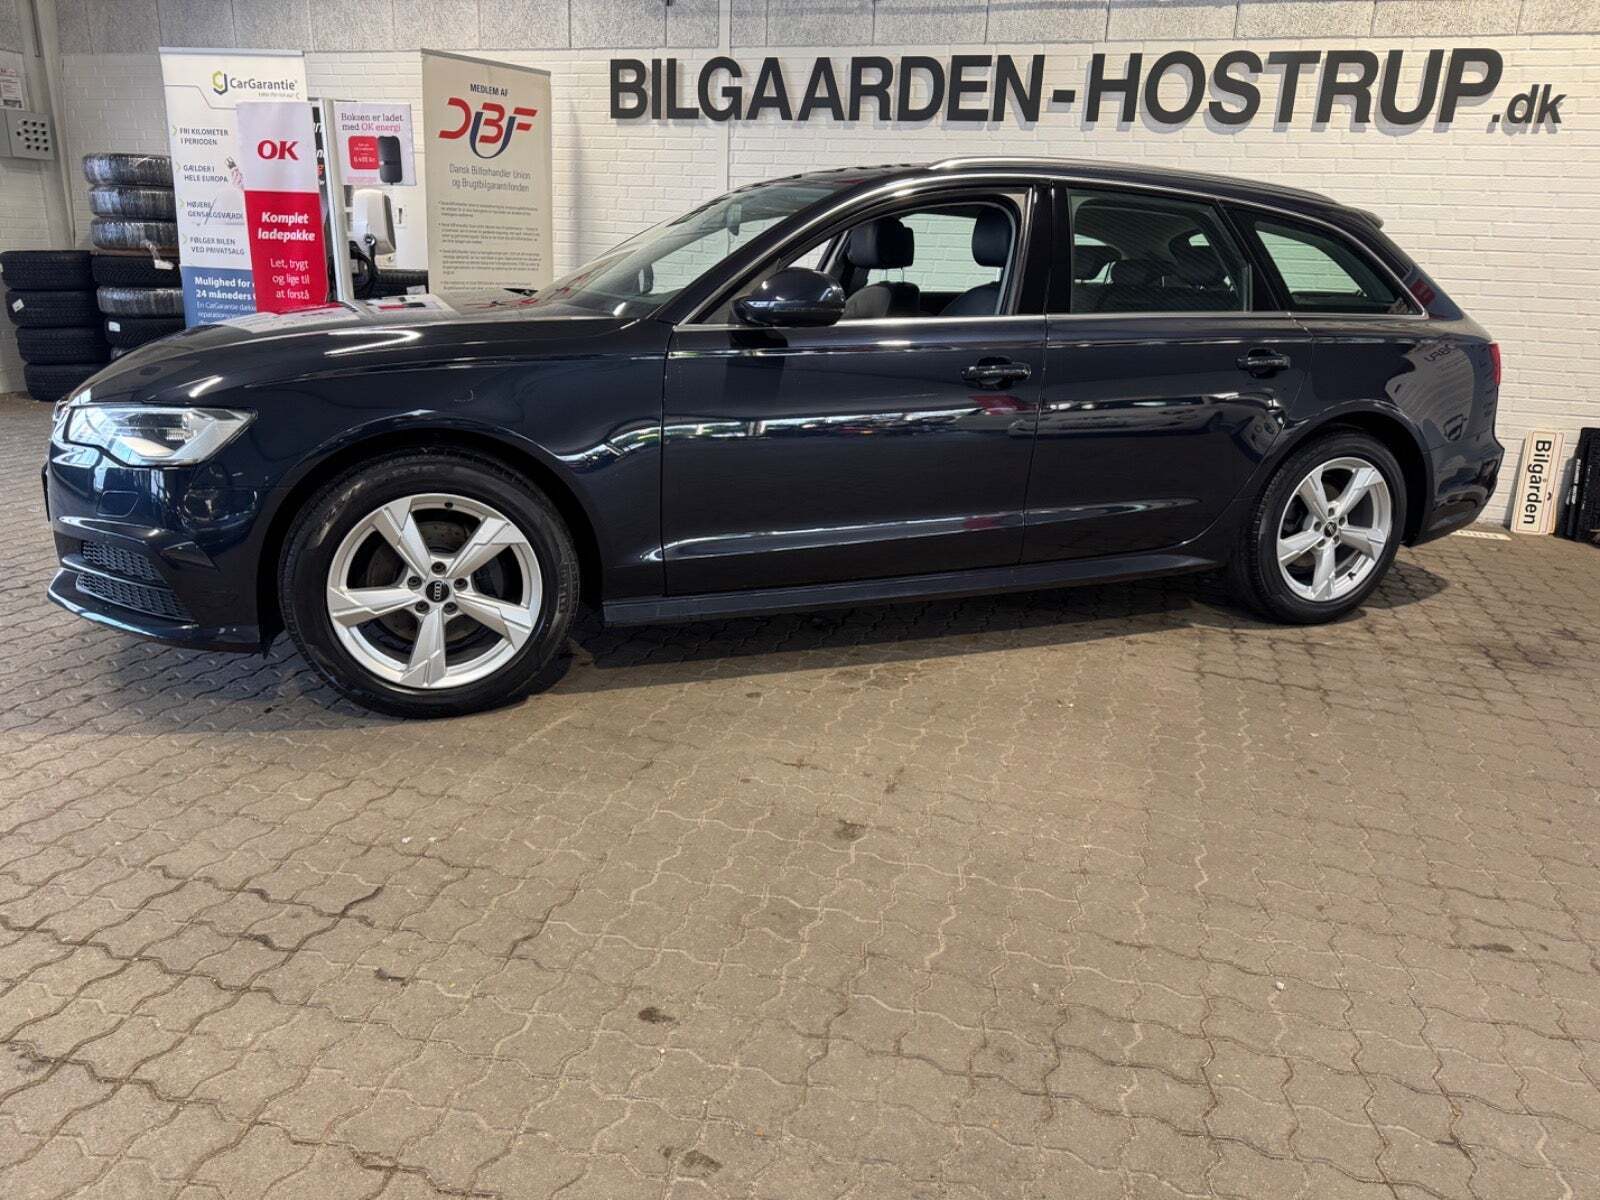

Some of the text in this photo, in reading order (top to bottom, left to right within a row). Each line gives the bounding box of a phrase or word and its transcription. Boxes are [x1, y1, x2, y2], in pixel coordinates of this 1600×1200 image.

[230, 78, 297, 91] CarGarantie
[470, 83, 508, 97] MEDLEM AF
[610, 48, 1566, 125] BILGAARDEN-HOSTRUP.dk
[341, 113, 370, 121] Boksen
[383, 113, 404, 122] ladet
[191, 128, 229, 136] KILOMETER
[342, 123, 401, 134] med OK energi
[257, 140, 299, 160] OK
[183, 164, 211, 172] GÆLDER
[449, 163, 469, 174] Dansk
[513, 168, 531, 180] Union
[202, 175, 229, 183] EUROPA
[452, 179, 460, 189] og
[261, 212, 309, 227] Komplet
[190, 236, 215, 244] FØLGER
[257, 228, 316, 243] ladepakke
[206, 247, 245, 255] PRIVATSALG
[270, 258, 309, 271] Let, trygt
[194, 276, 236, 288] Mulighed
[238, 278, 251, 288] for
[272, 273, 310, 286] og lige til
[196, 289, 207, 298] 24
[208, 289, 252, 300] måneders
[276, 289, 310, 300] at forstå
[1523, 440, 1552, 524] Bilgården
